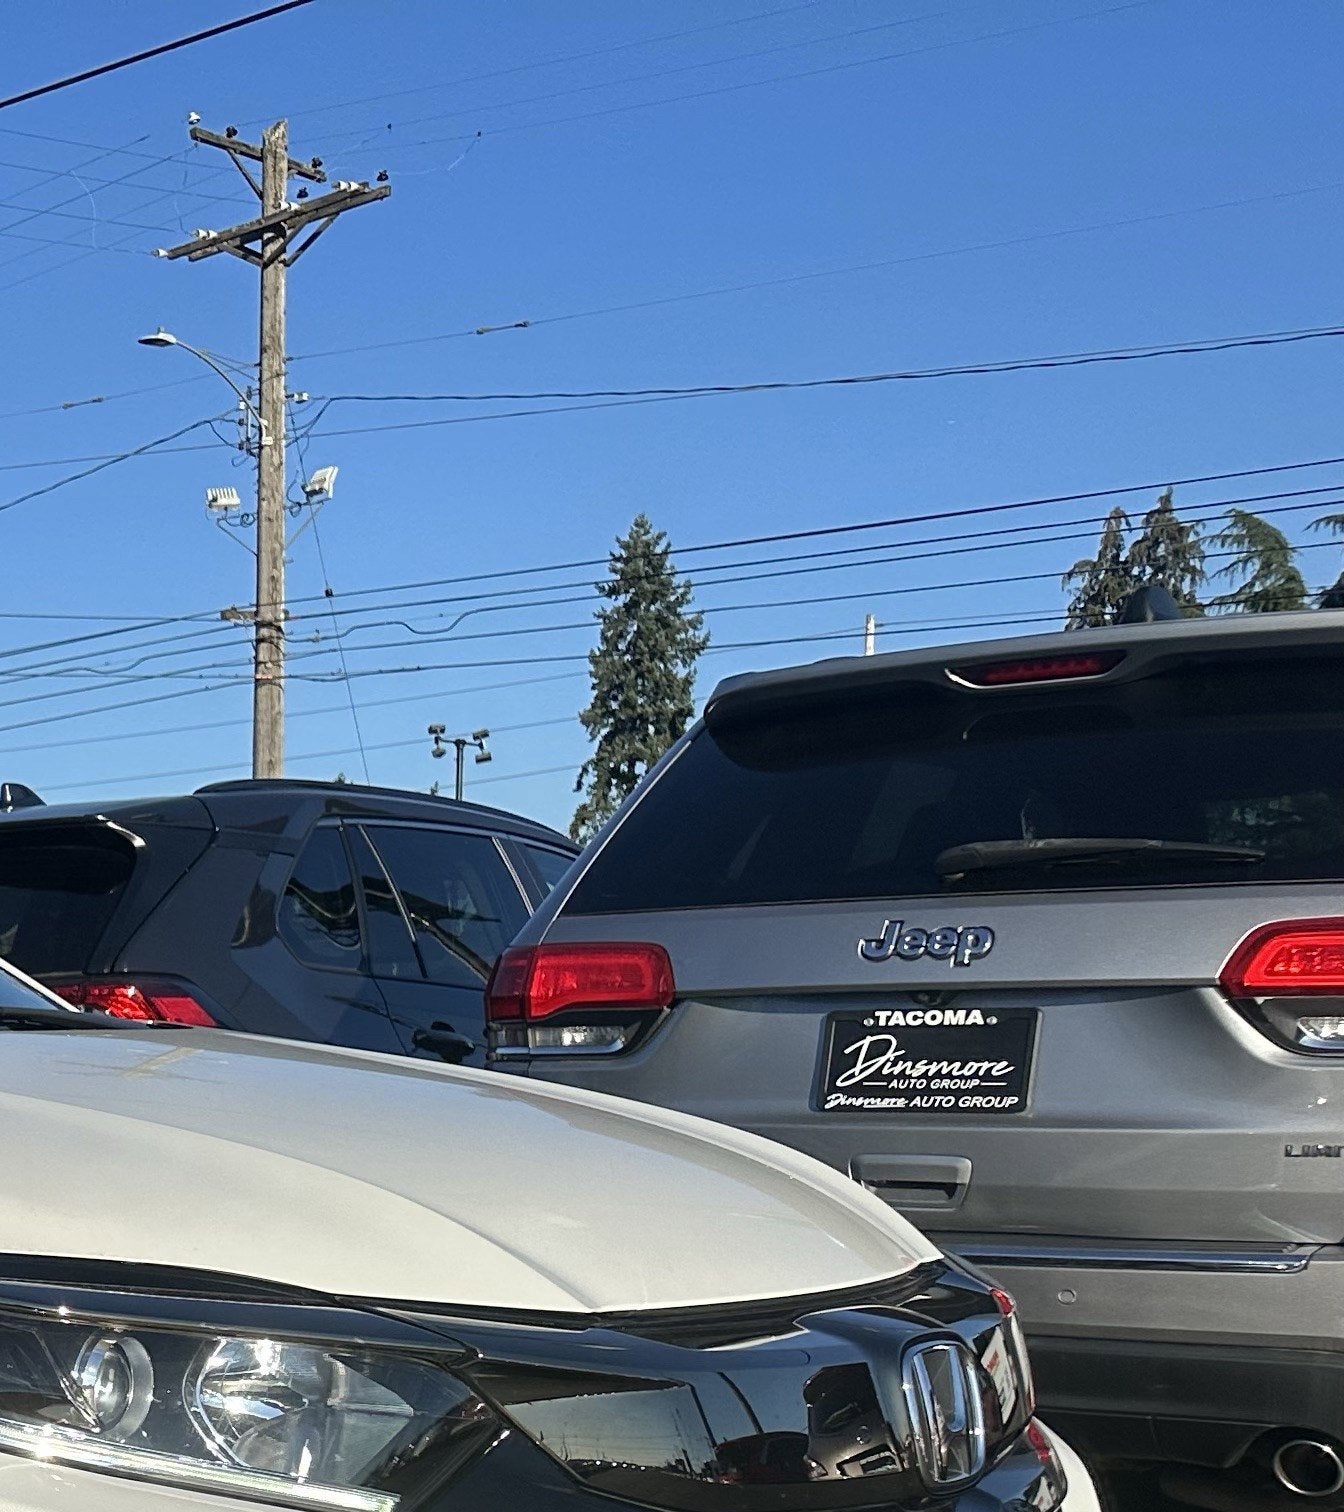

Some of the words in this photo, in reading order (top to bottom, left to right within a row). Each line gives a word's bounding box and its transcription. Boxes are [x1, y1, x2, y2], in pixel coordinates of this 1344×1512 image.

[857, 919, 995, 968] Jeep
[874, 1009, 984, 1027] TACOMA
[835, 1034, 1016, 1088] Dinsmore
[888, 1078, 927, 1090] AUTO
[930, 1078, 981, 1090] GROUP
[909, 1095, 955, 1108] AUTO
[958, 1095, 1020, 1108] GROUP
